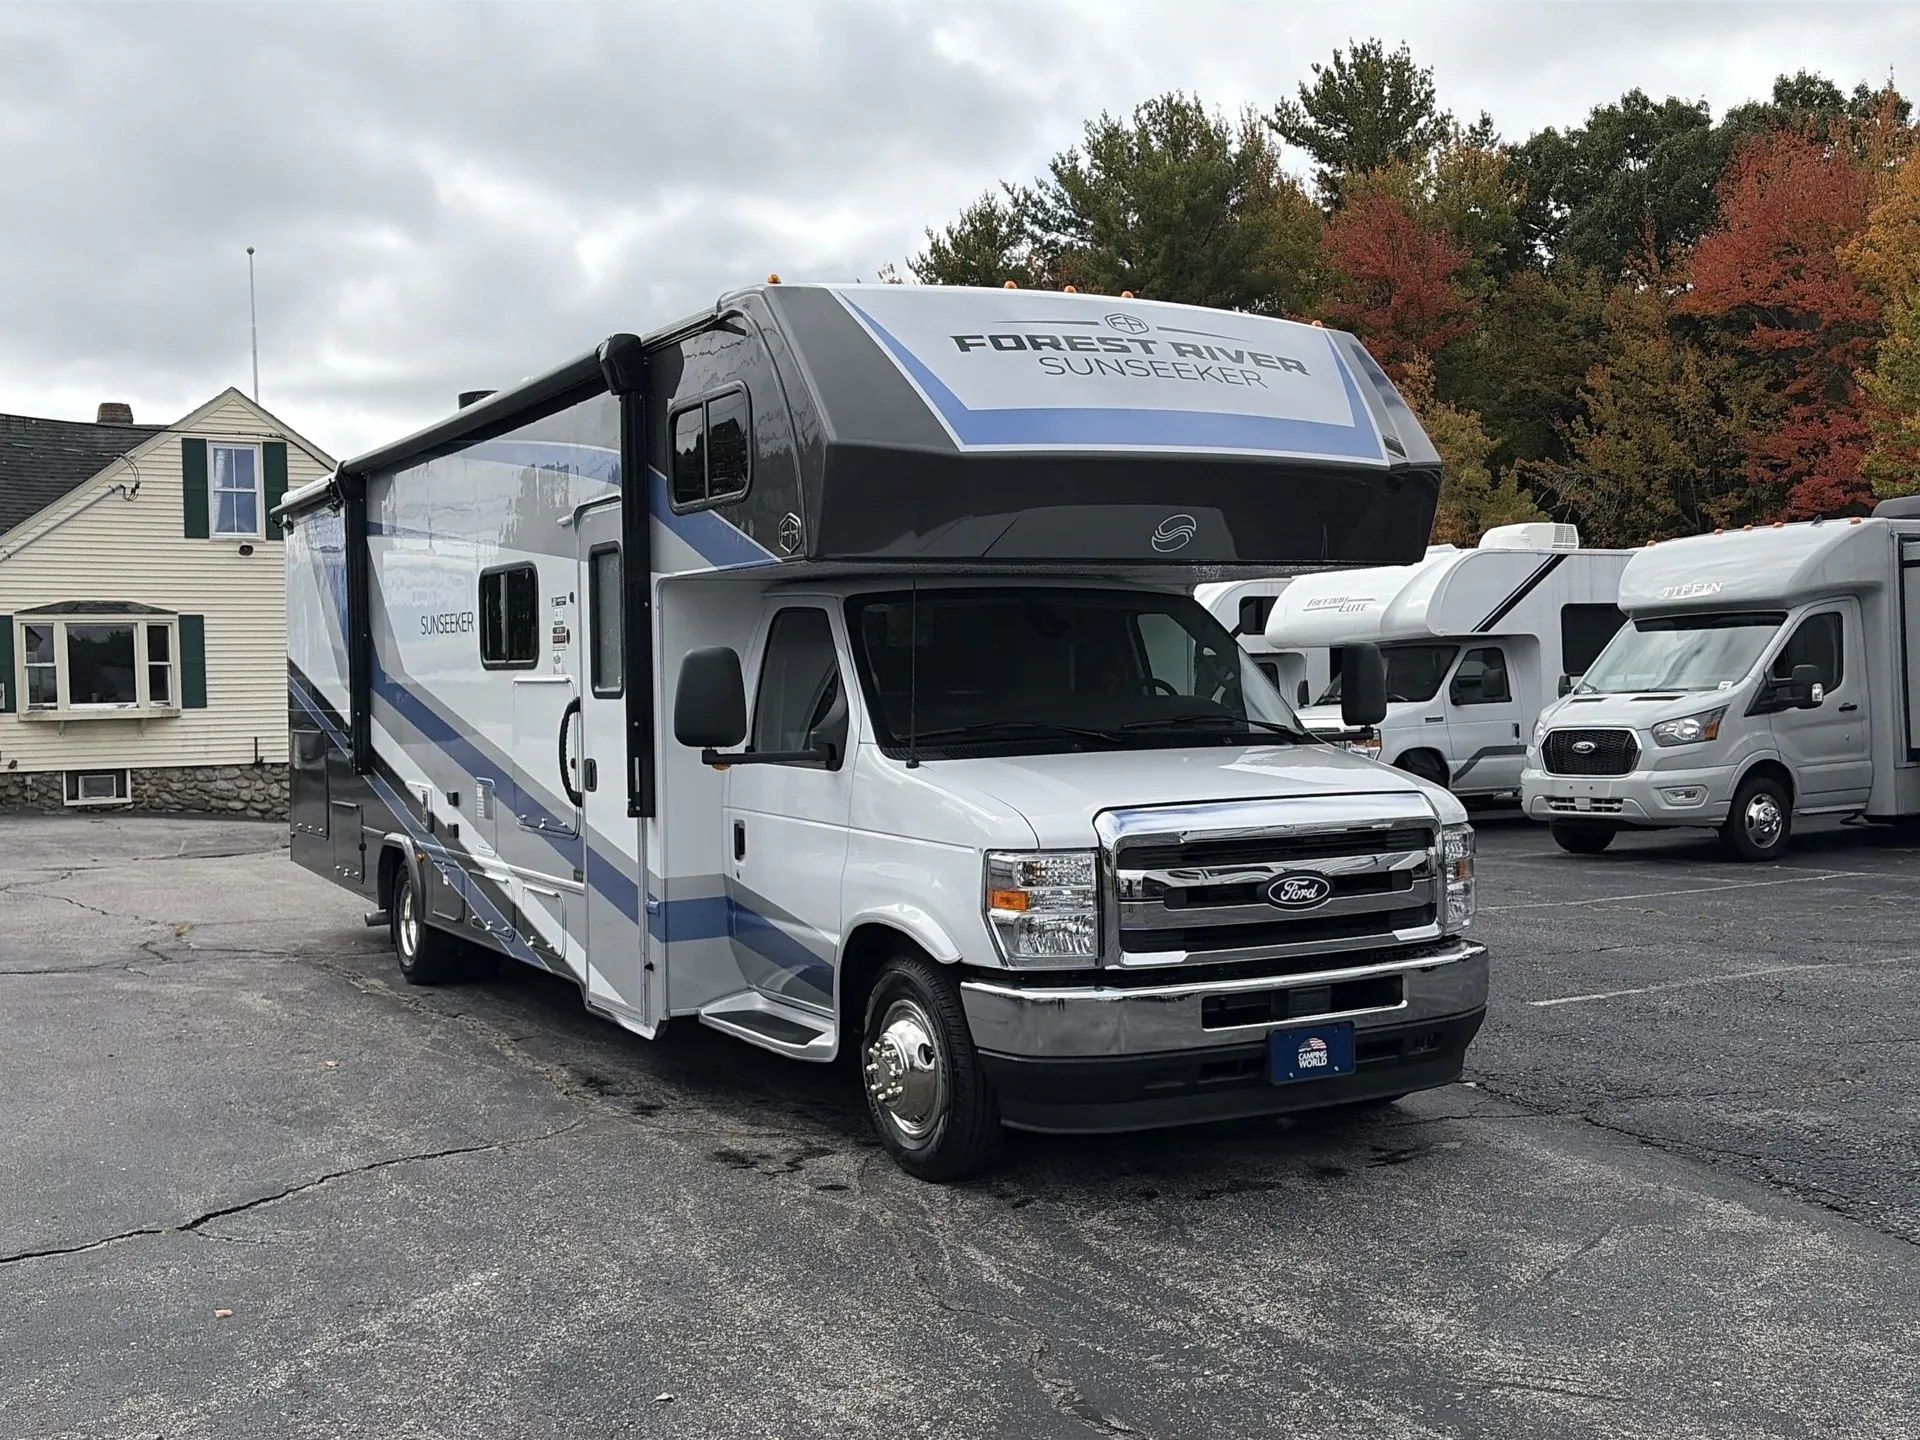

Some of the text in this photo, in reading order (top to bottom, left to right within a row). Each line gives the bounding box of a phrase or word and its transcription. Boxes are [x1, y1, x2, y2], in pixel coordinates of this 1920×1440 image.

[949, 334, 1312, 377] FOREST RIVER
[1038, 356, 1269, 389] SUNSEEKER
[1662, 582, 1724, 599] TIFFIN
[1306, 596, 1350, 608] FREEDOM
[1338, 602, 1371, 613] ELITE
[420, 611, 475, 636] SUNSEEKER
[1280, 879, 1319, 901] Ford
[1298, 1050, 1328, 1061] CAMPING
[1298, 1057, 1328, 1069] WORLD
